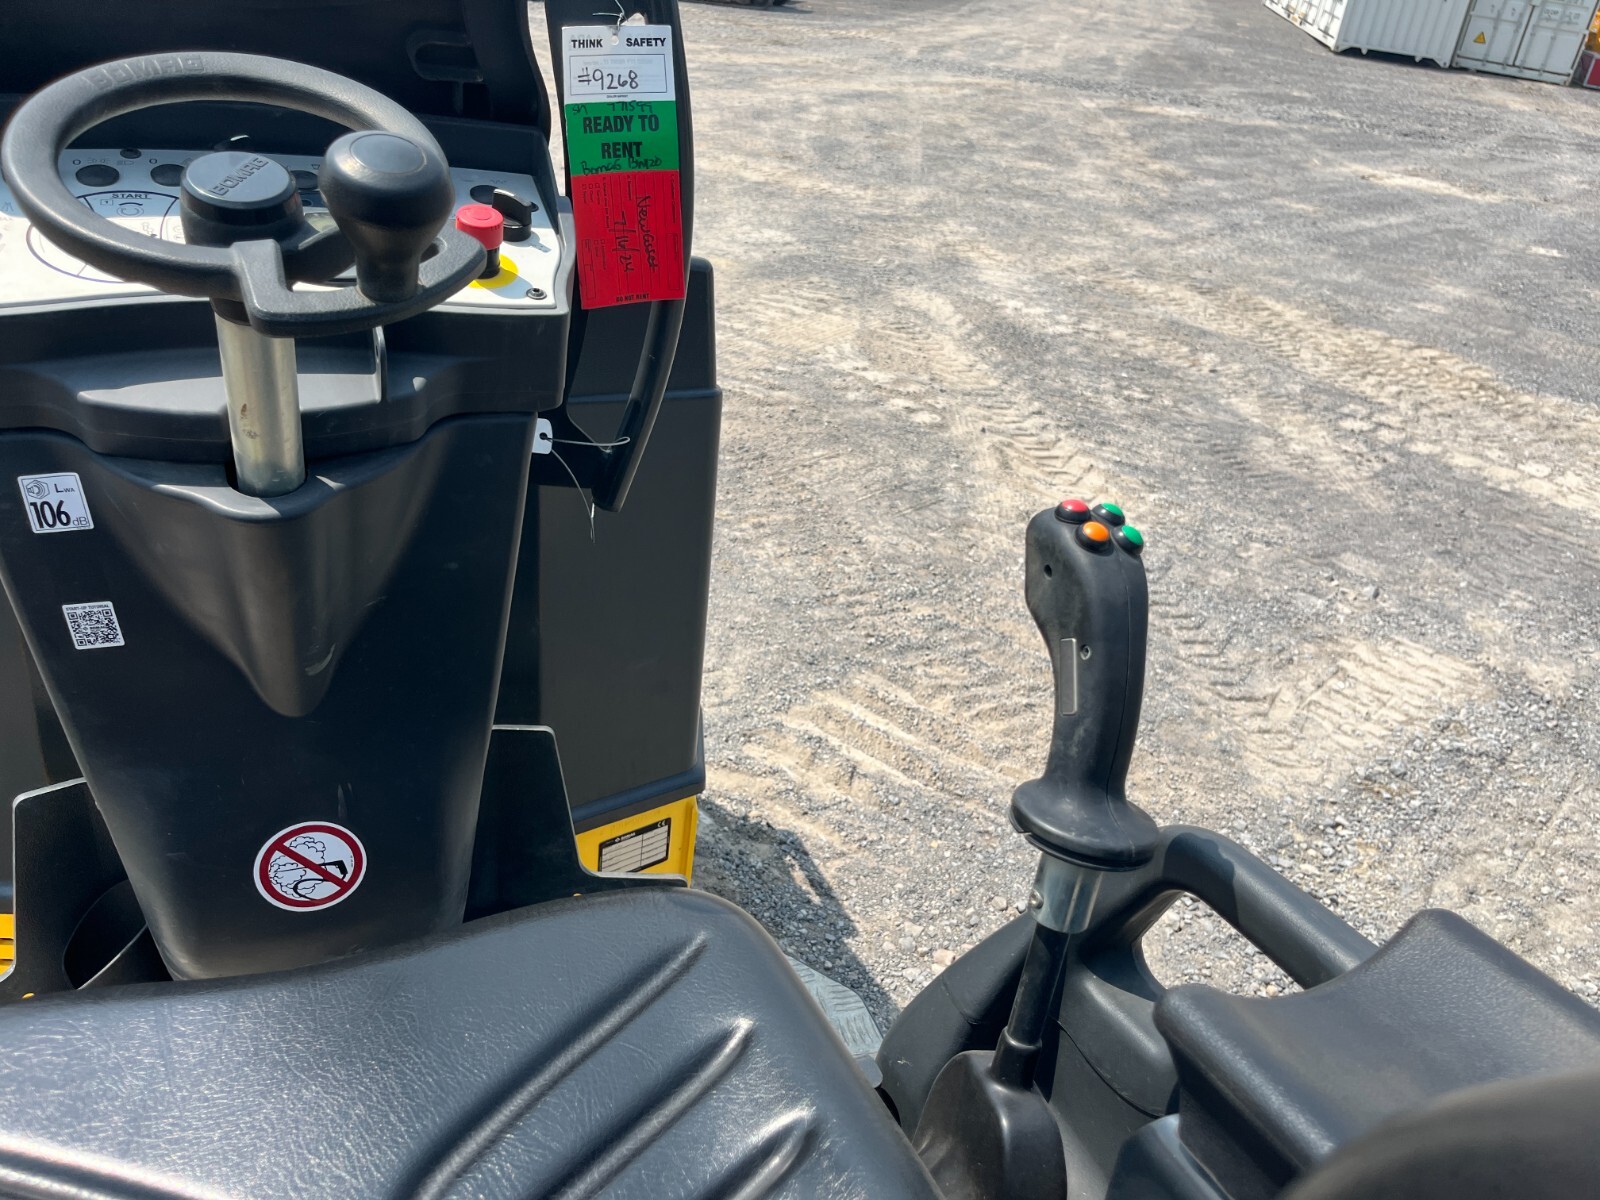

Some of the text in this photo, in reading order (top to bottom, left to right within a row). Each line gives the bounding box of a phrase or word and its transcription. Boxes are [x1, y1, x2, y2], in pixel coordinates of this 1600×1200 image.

[571, 37, 666, 49] THINK SAFETY
[81, 55, 205, 91] BOMAG
[577, 67, 640, 91] #9268
[583, 114, 660, 134] READY TO
[601, 141, 643, 159] RENT
[209, 157, 269, 197] BOMAG
[29, 499, 71, 529] 106
[72, 516, 88, 527] dB
